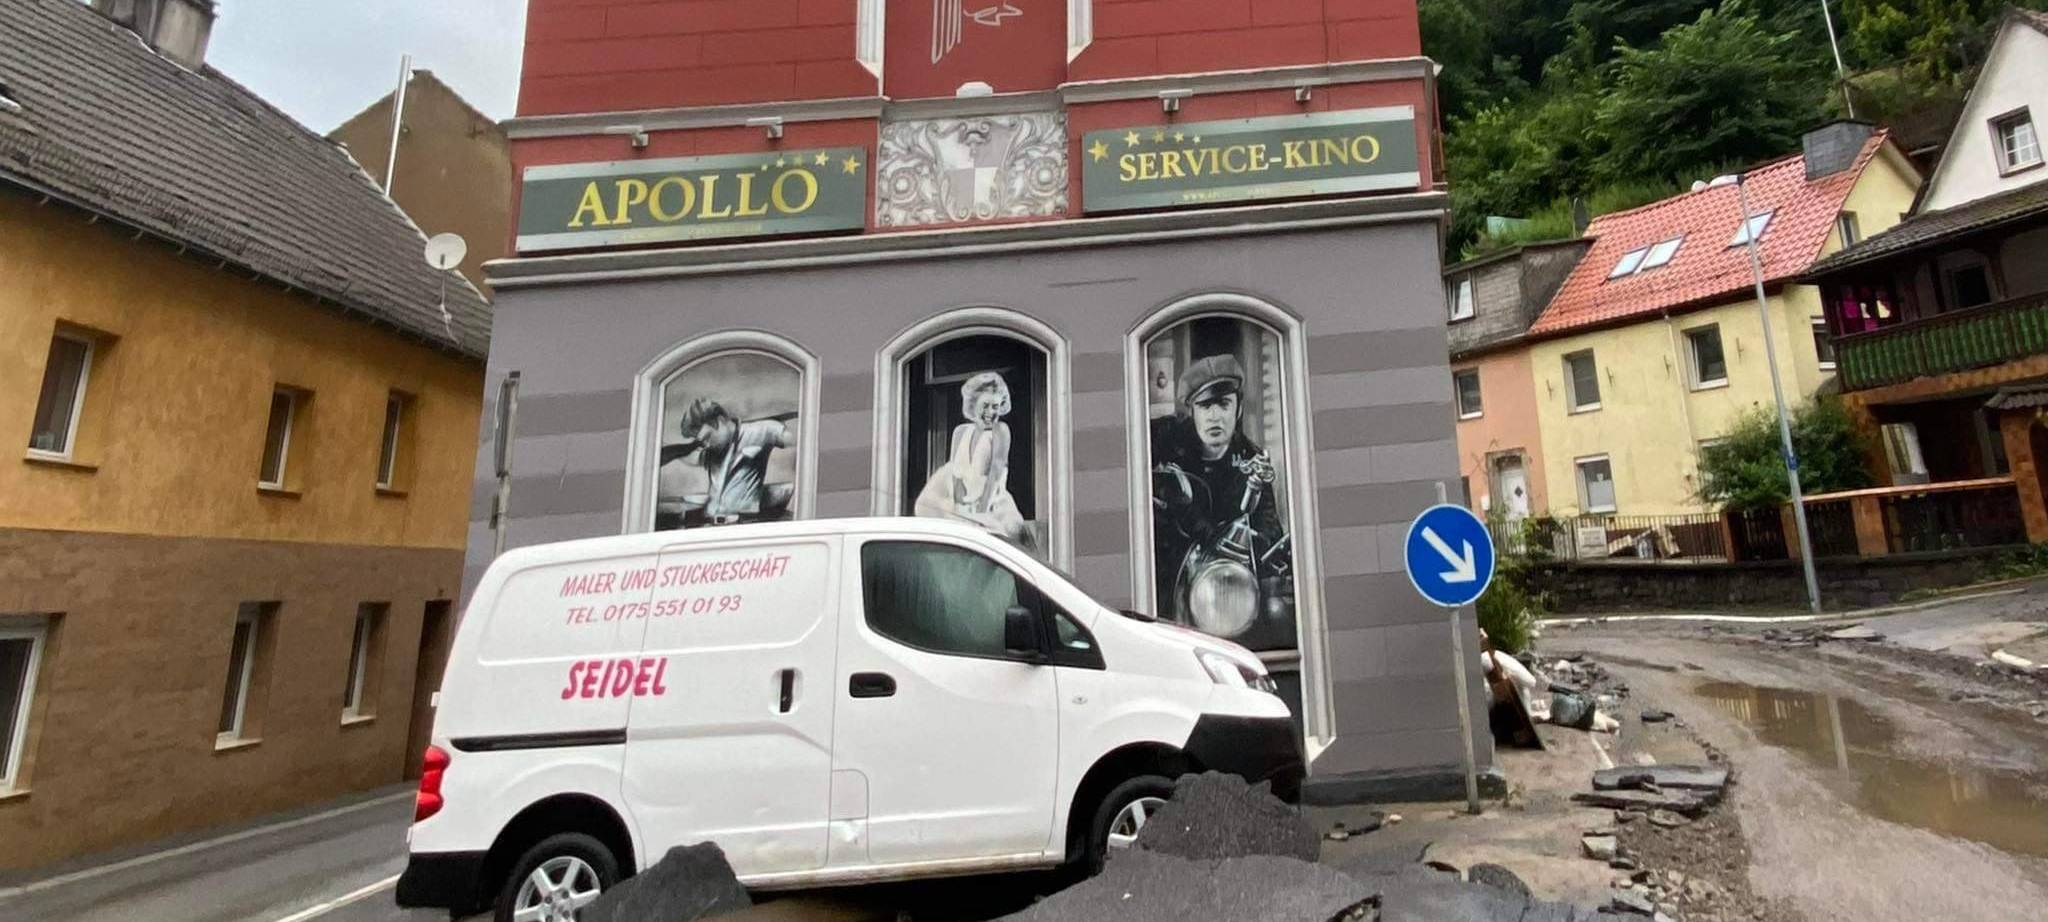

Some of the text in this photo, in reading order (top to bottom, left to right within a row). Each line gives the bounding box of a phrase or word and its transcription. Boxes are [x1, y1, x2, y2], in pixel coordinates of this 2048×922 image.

[1119, 135, 1381, 183] SERVICE-KINO
[568, 168, 819, 227] APOLLO
[560, 554, 790, 598] MALER UND STUCKGESCHÄFT
[566, 594, 742, 625] TEL. 0175 551 01 93
[561, 656, 668, 701] SEIDEL
